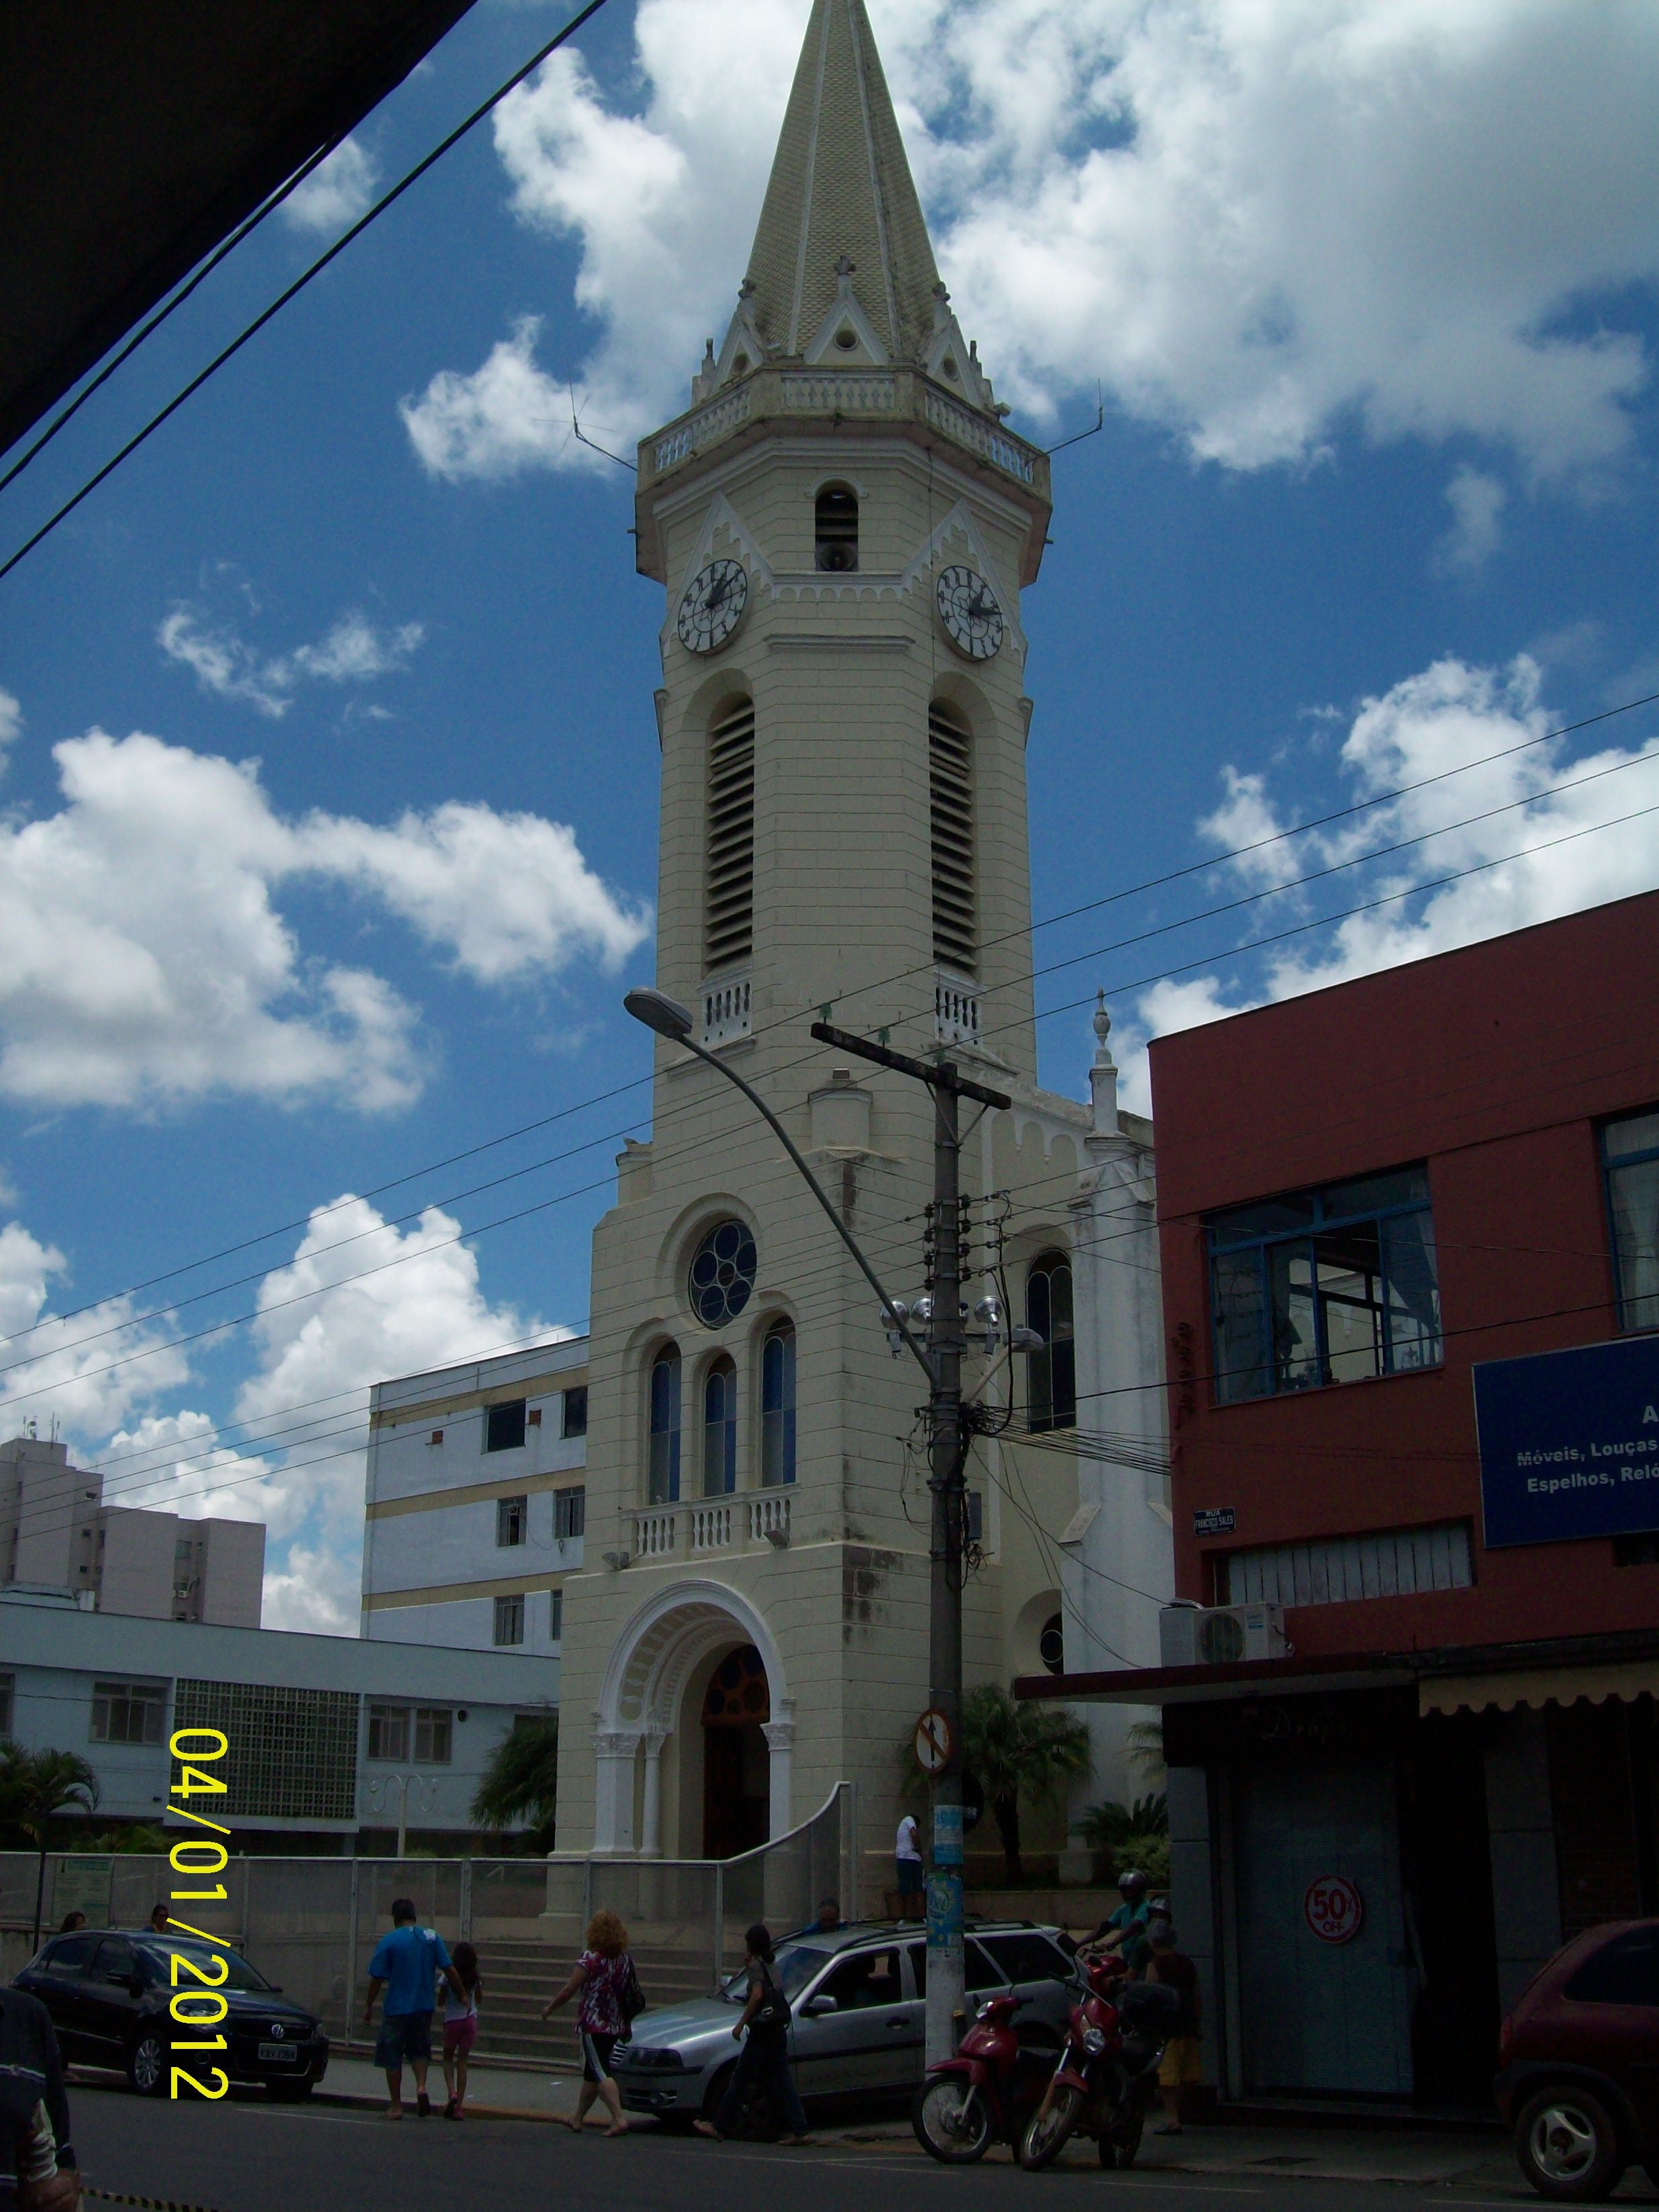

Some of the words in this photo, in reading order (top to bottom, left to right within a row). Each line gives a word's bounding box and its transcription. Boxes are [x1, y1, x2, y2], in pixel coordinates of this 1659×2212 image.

[1517, 1447, 1586, 1467] Móveis,
[1527, 1472, 1615, 1495] Espelhos,
[1219, 1515, 1234, 1525] SALES
[1323, 1921, 1344, 1933] OFF
